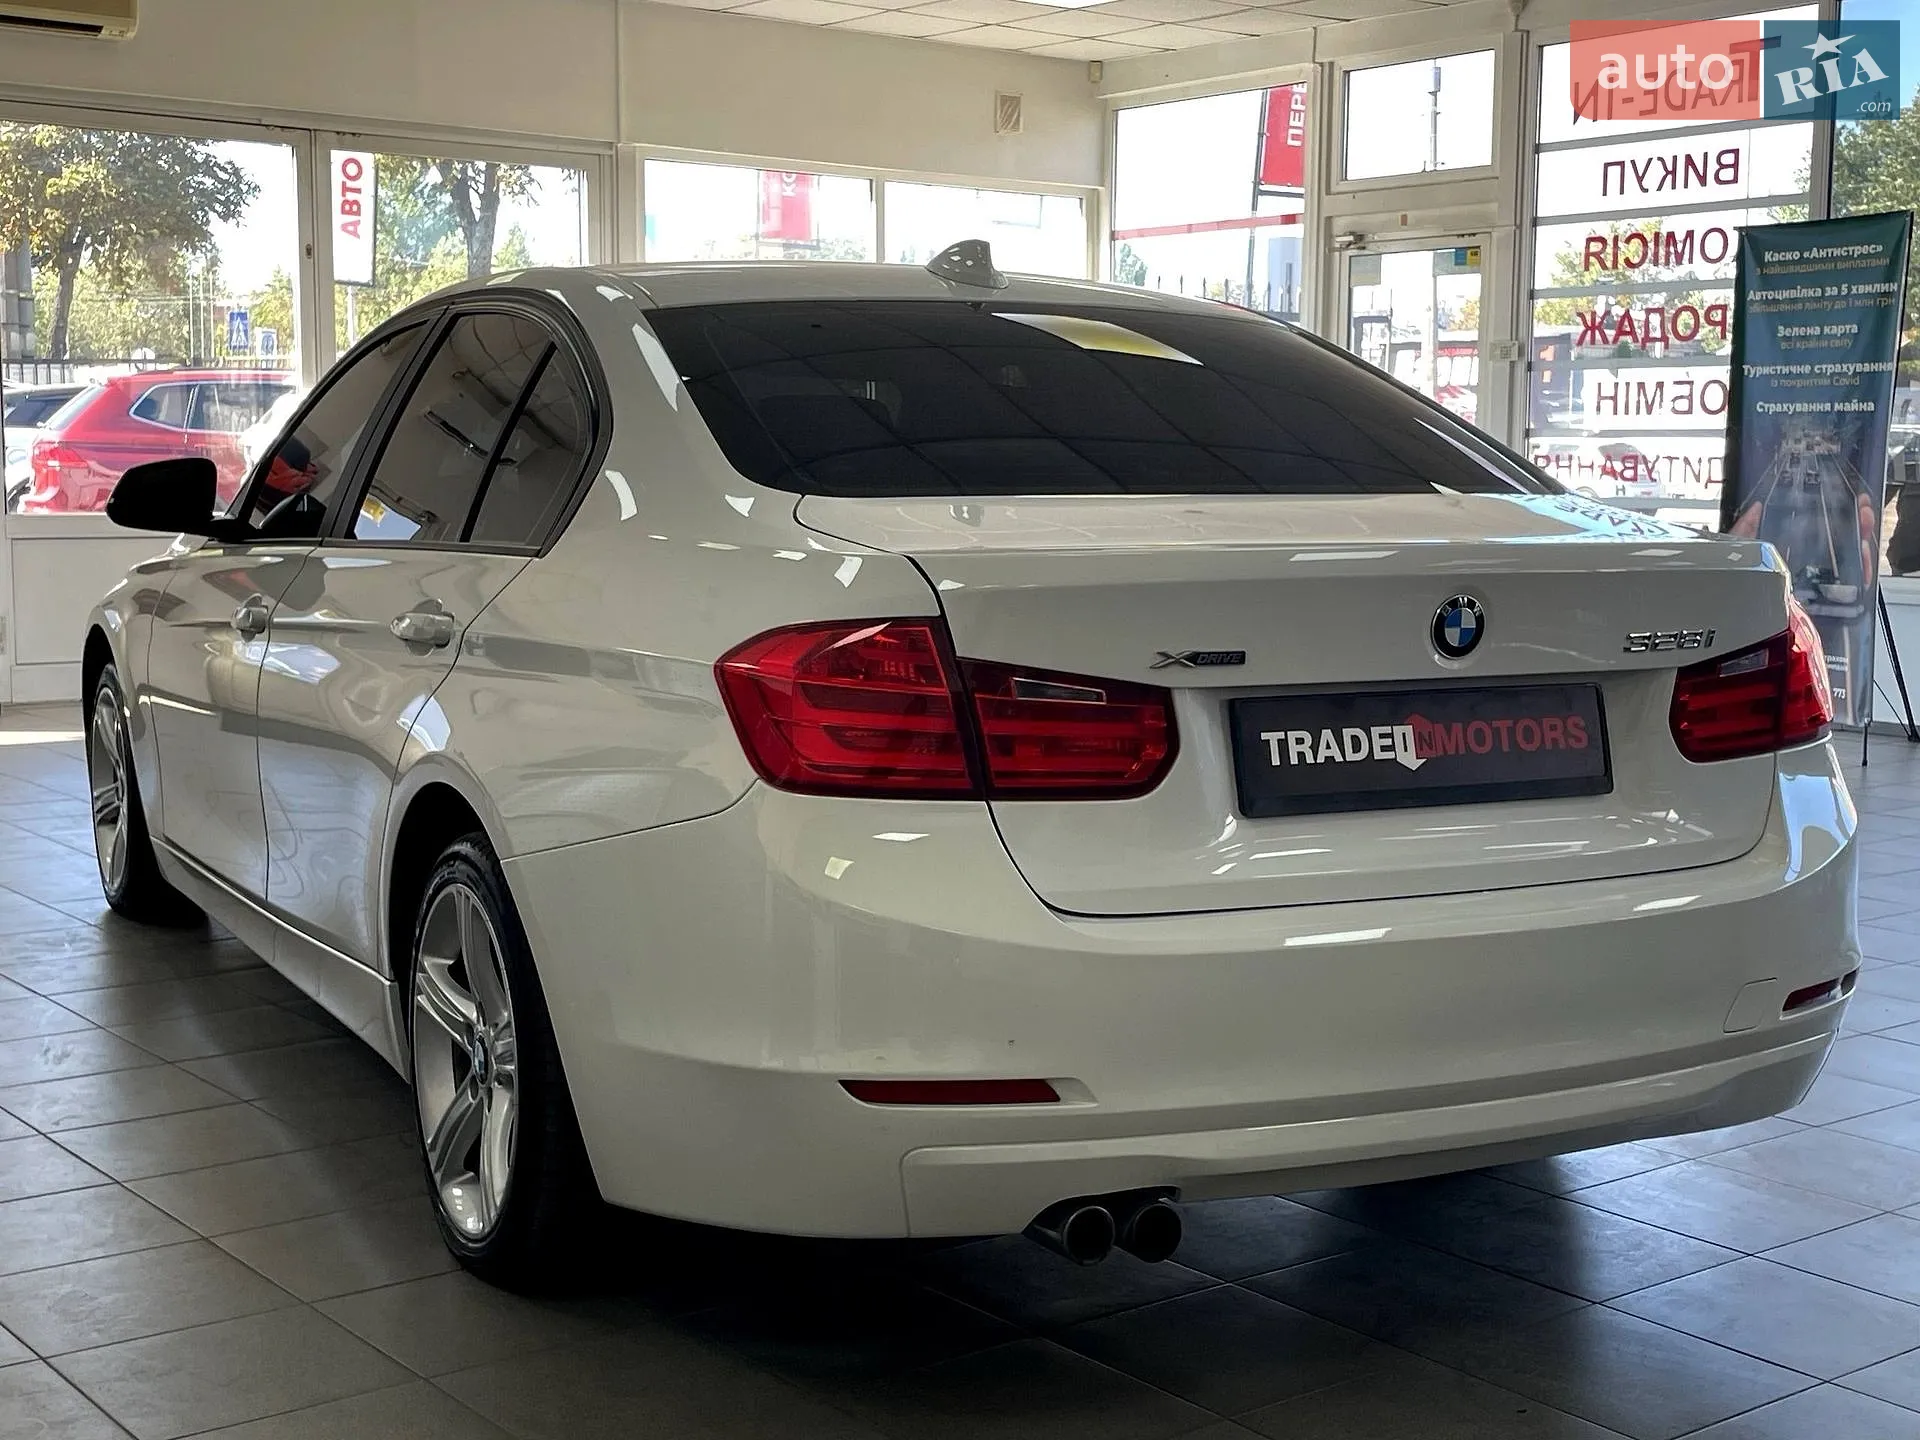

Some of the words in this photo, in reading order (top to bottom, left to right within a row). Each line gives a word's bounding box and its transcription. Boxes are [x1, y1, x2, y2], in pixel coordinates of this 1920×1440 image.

[341, 157, 363, 240] АВТО
[1764, 249, 1800, 262] Каско
[1747, 285, 1822, 301] Автоцивілка
[1825, 286, 1839, 296] за
[1841, 284, 1848, 295] 5
[1851, 282, 1898, 294] хвилин
[1777, 324, 1820, 337] Зелена
[1823, 323, 1858, 337] карта
[1742, 364, 1812, 377] Туристичне
[1814, 362, 1893, 377] страхування
[1756, 401, 1831, 414] Страхування
[1834, 399, 1875, 412] майна
[1623, 630, 1716, 652] 328i
